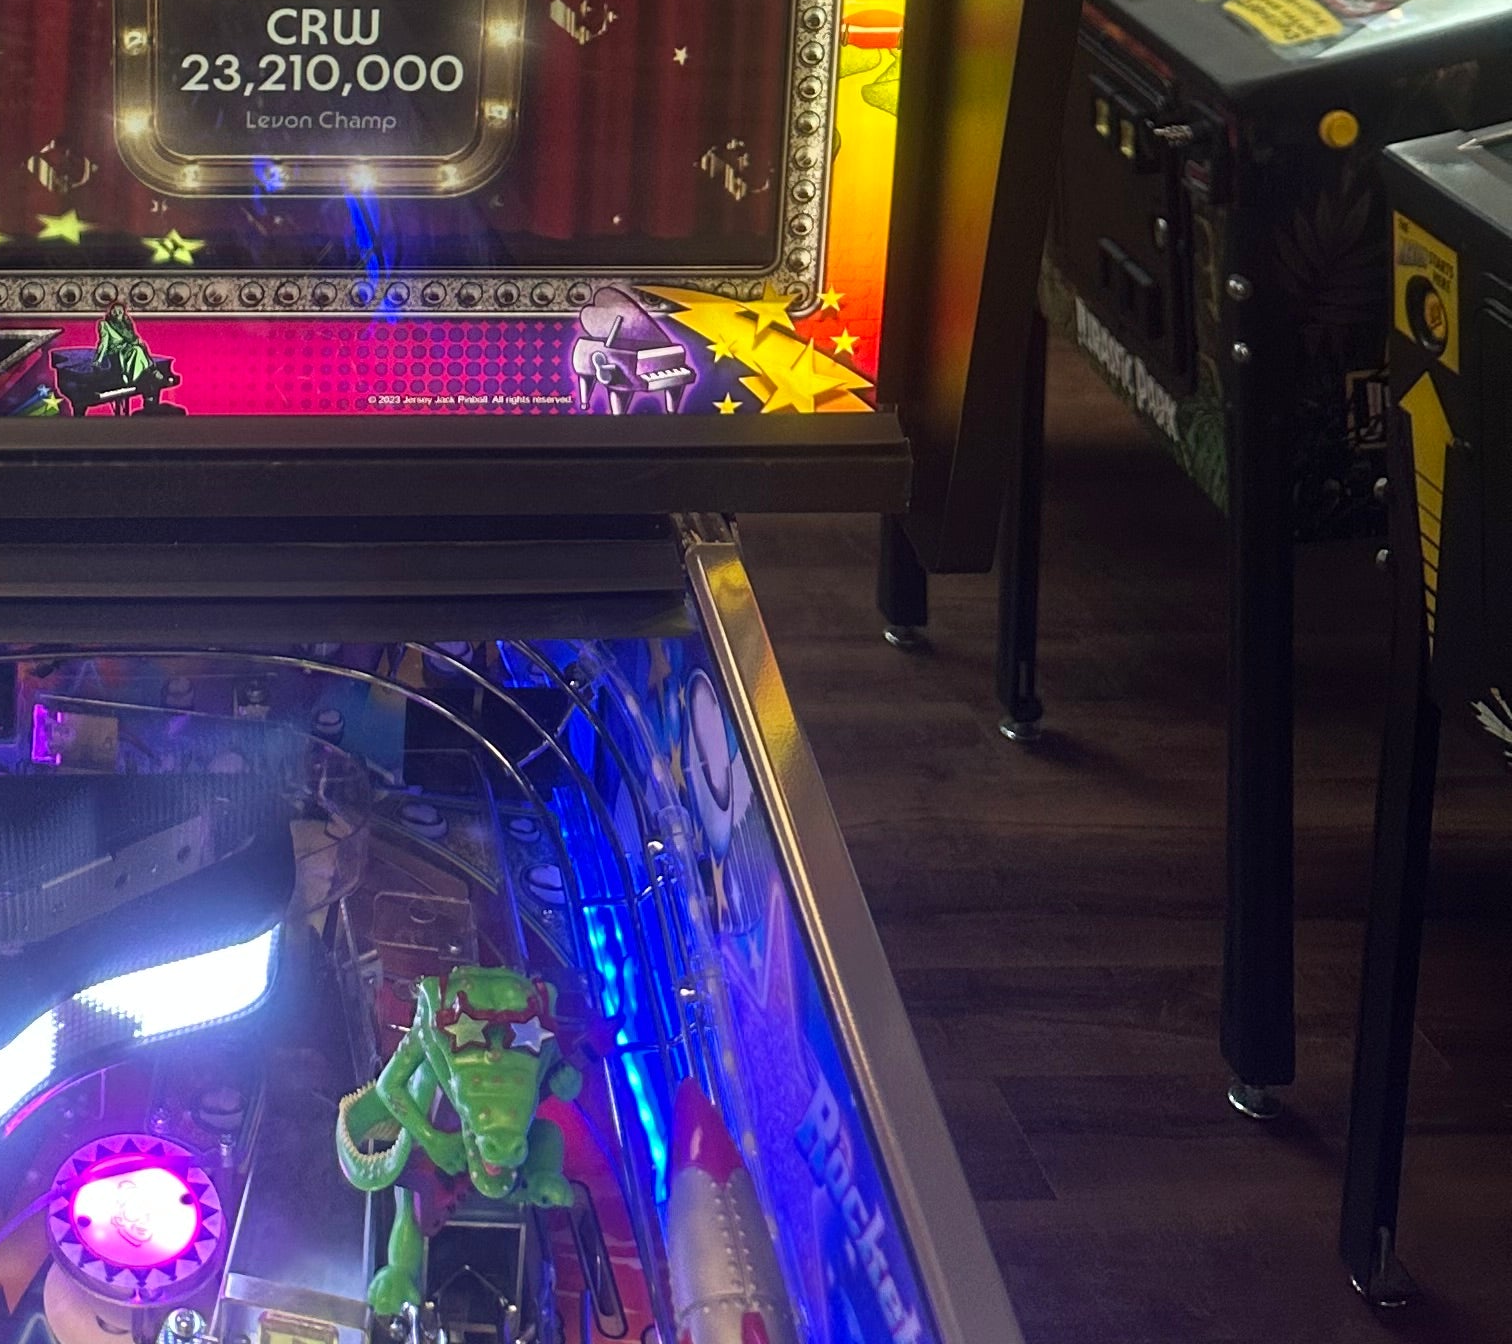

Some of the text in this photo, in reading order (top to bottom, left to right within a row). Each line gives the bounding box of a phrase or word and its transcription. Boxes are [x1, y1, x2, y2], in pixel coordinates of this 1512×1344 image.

[266, 8, 381, 45] CRW
[180, 53, 464, 97] 23,210,000
[246, 111, 398, 133] Levon Champ
[378, 396, 401, 404] 2023
[402, 396, 433, 405] Jersey
[434, 395, 456, 404] Jack
[491, 395, 504, 404] All
[505, 395, 531, 405] rights
